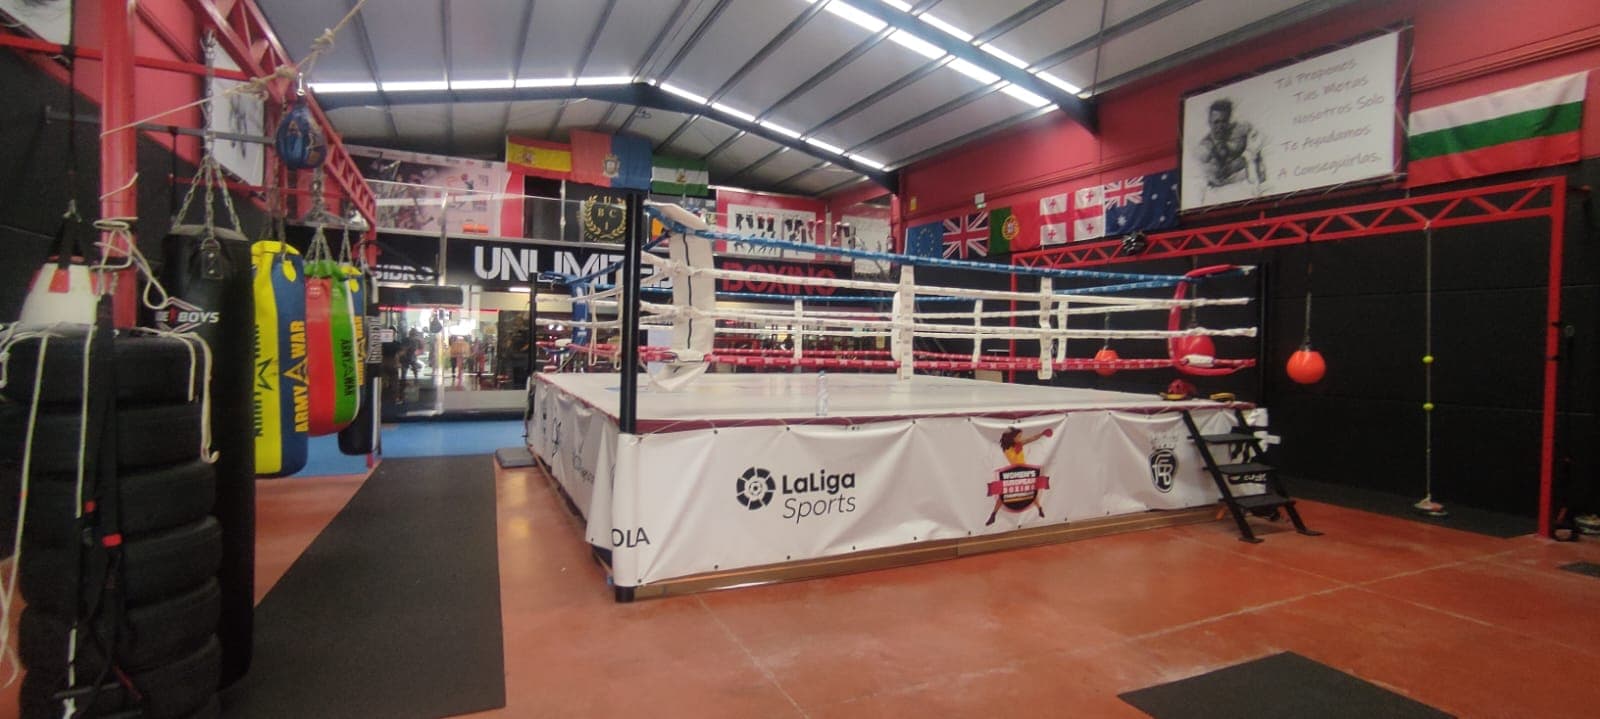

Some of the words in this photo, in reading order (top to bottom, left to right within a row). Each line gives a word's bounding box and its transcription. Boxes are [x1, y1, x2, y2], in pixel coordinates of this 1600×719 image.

[1355, 92, 1385, 111] Solo
[474, 245, 673, 289] UNLIMIT
[177, 311, 220, 324] BOYS
[289, 320, 306, 359] WAR
[293, 386, 309, 433] ARMY
[782, 470, 856, 495] LaLiga
[782, 493, 856, 524] Sports
